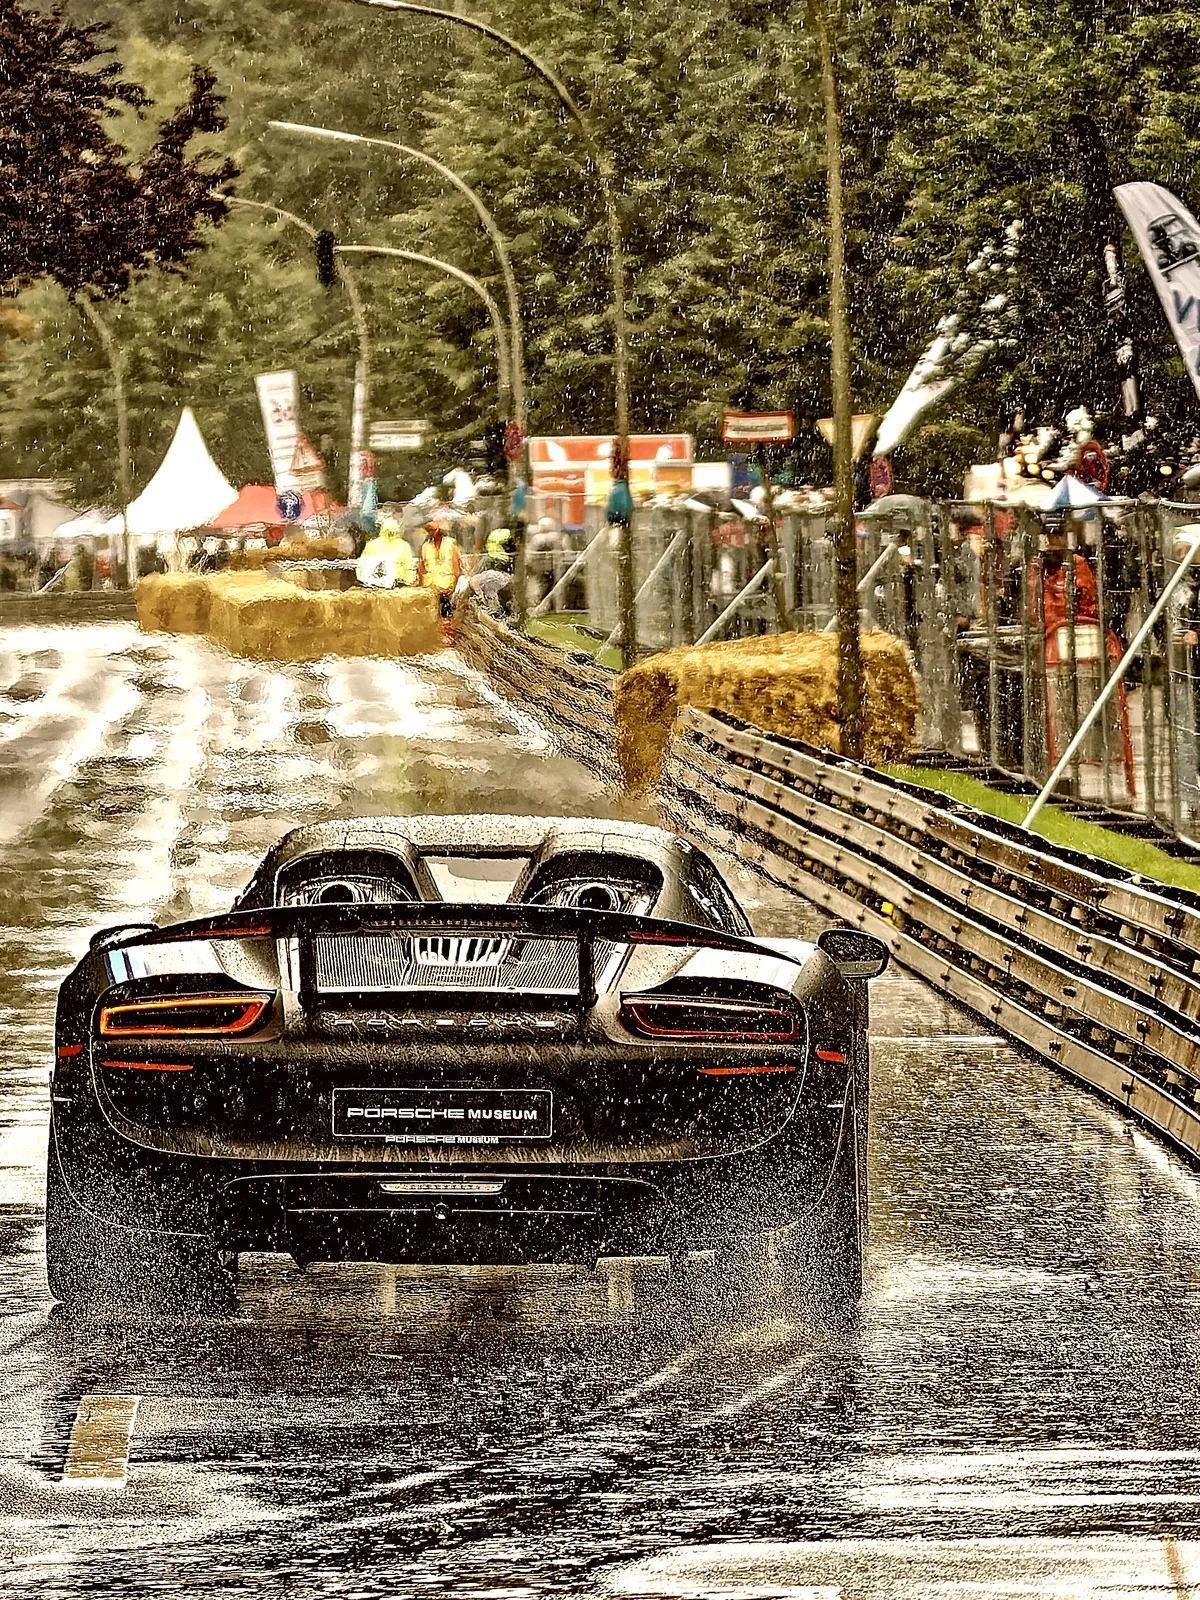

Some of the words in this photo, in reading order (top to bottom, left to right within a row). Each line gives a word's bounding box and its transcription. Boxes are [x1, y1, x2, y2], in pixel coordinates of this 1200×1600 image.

[347, 1107, 465, 1120] PORSCHE
[467, 1109, 538, 1121] MUSEUM
[385, 1135, 456, 1144] PORSCHE
[456, 1136, 500, 1145] MUSEUM
